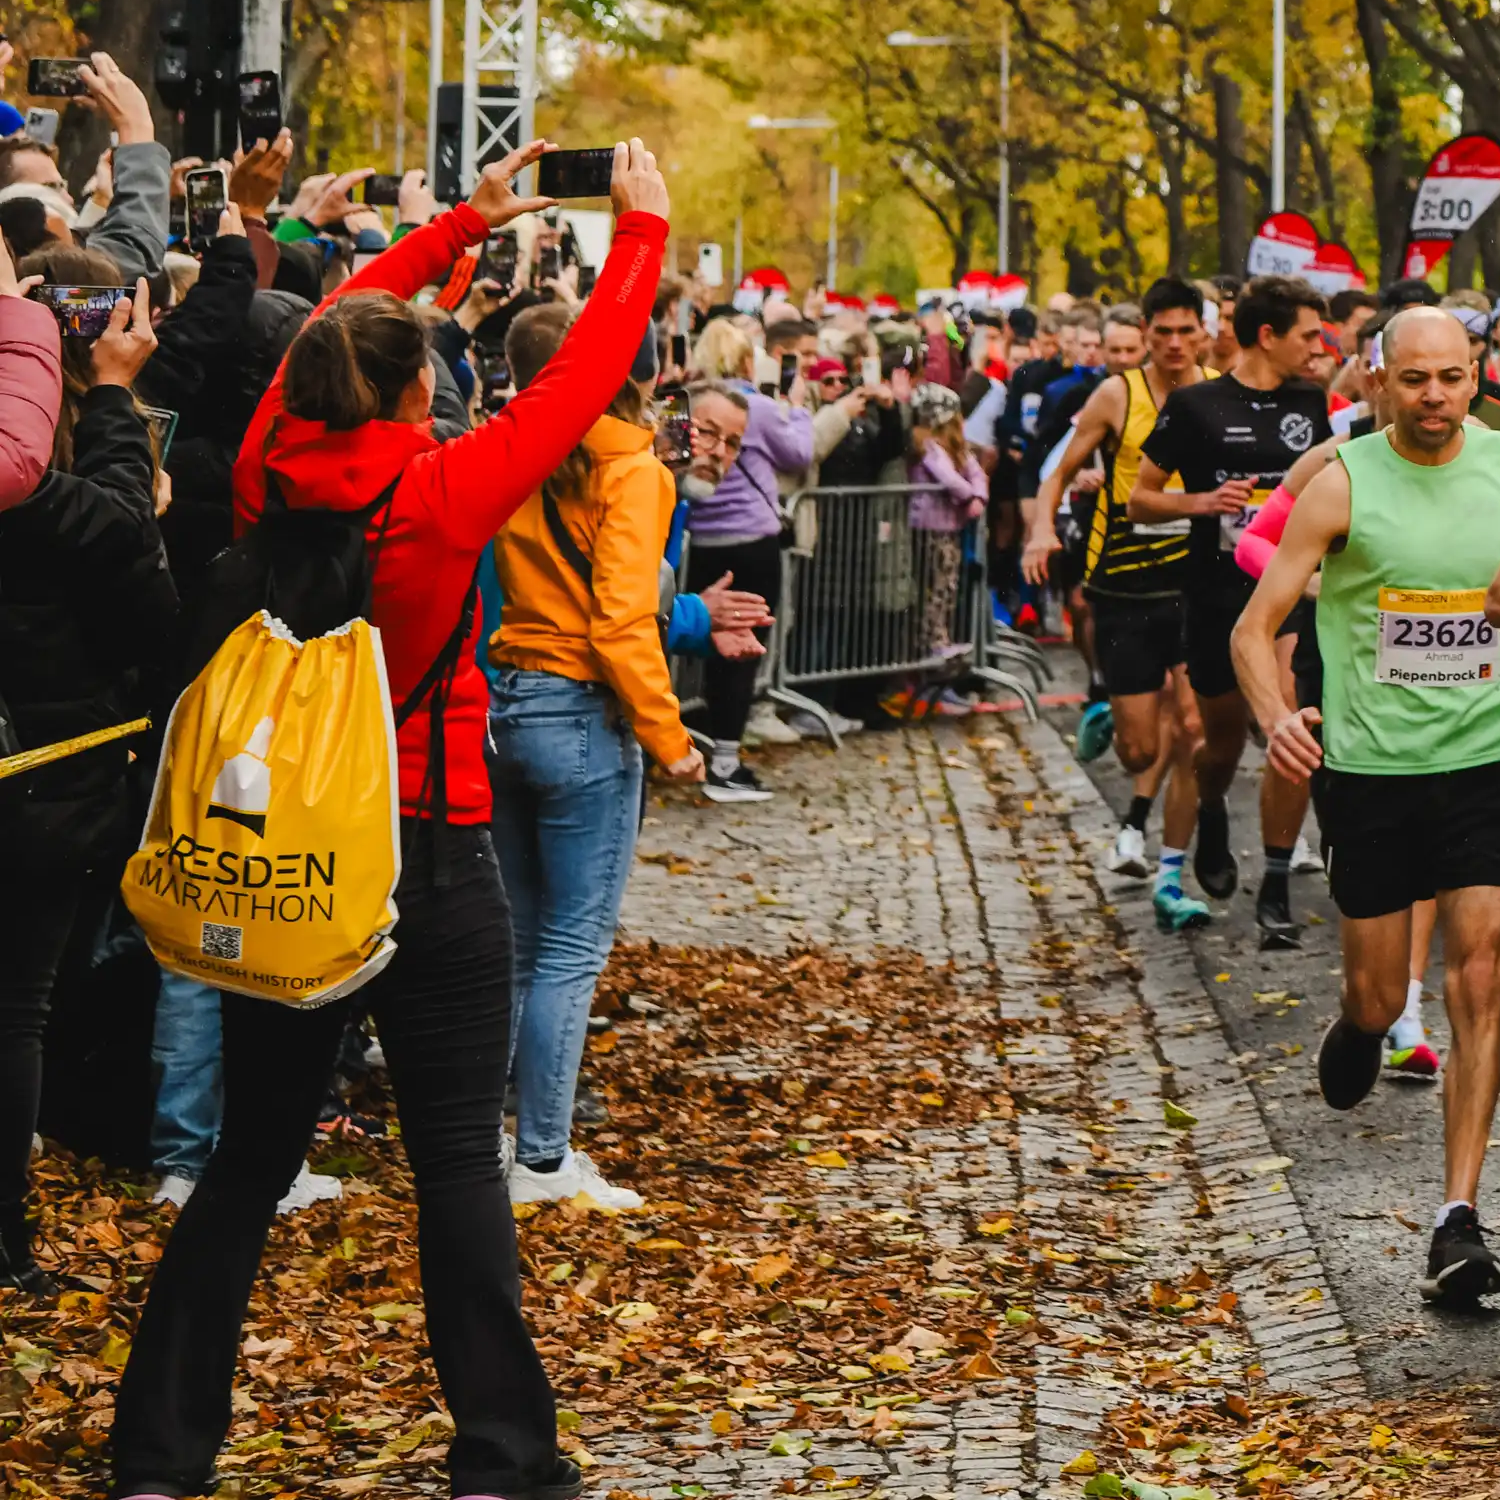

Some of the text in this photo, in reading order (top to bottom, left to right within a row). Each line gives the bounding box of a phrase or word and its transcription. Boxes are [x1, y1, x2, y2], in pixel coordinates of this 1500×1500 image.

[1419, 199, 1473, 223] 3:00
[616, 243, 651, 304] DIDRIKSONS
[1400, 593, 1448, 604] DRESDEN
[1393, 619, 1493, 647] 23626
[1424, 652, 1464, 662] Ahmad
[1390, 668, 1476, 683] Piepenbrock
[140, 859, 334, 923] MARATHON
[252, 971, 324, 991] HISTORY
